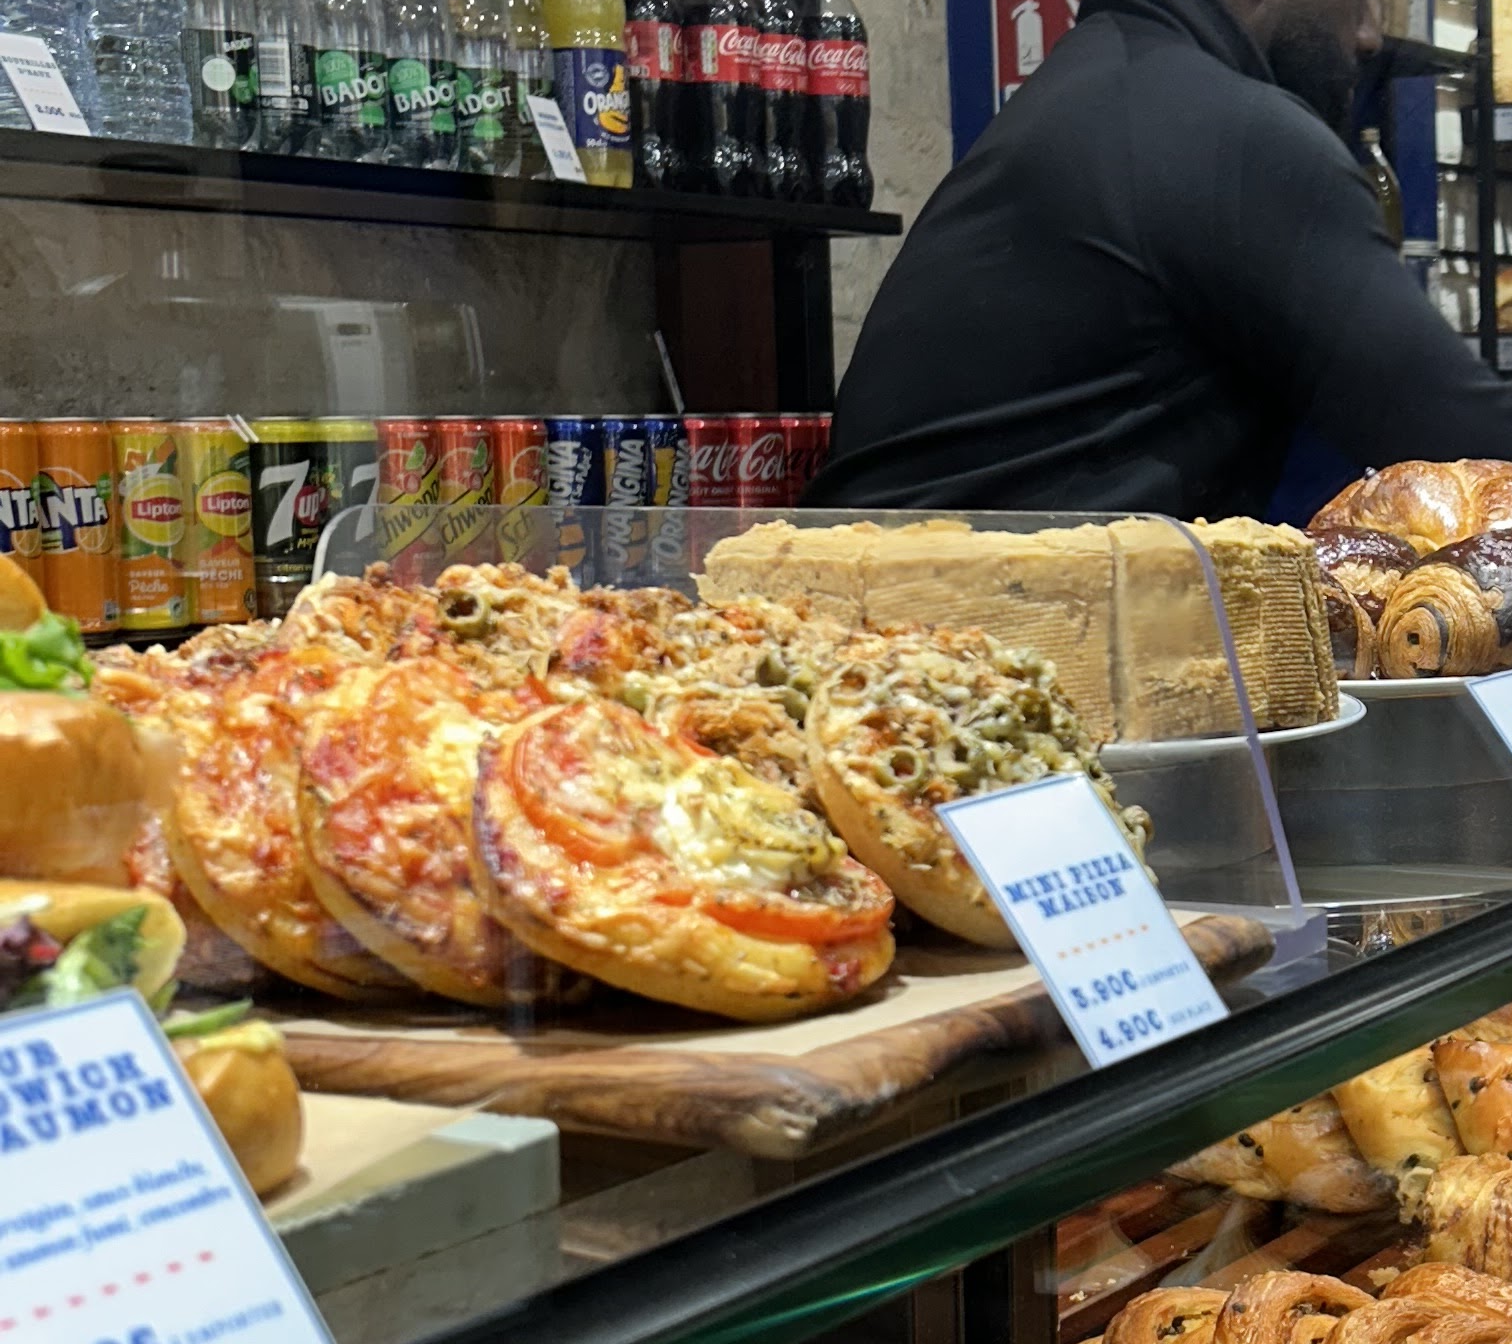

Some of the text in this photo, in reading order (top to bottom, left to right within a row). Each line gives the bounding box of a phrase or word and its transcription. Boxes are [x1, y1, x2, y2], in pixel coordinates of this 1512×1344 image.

[136, 500, 182, 519] Lipton
[206, 494, 250, 513] Lipton
[259, 459, 310, 547] 7
[1003, 852, 1134, 904] MINI PIZZA
[1036, 876, 1127, 919] MAISON
[1098, 1008, 1164, 1051] 4.90€
